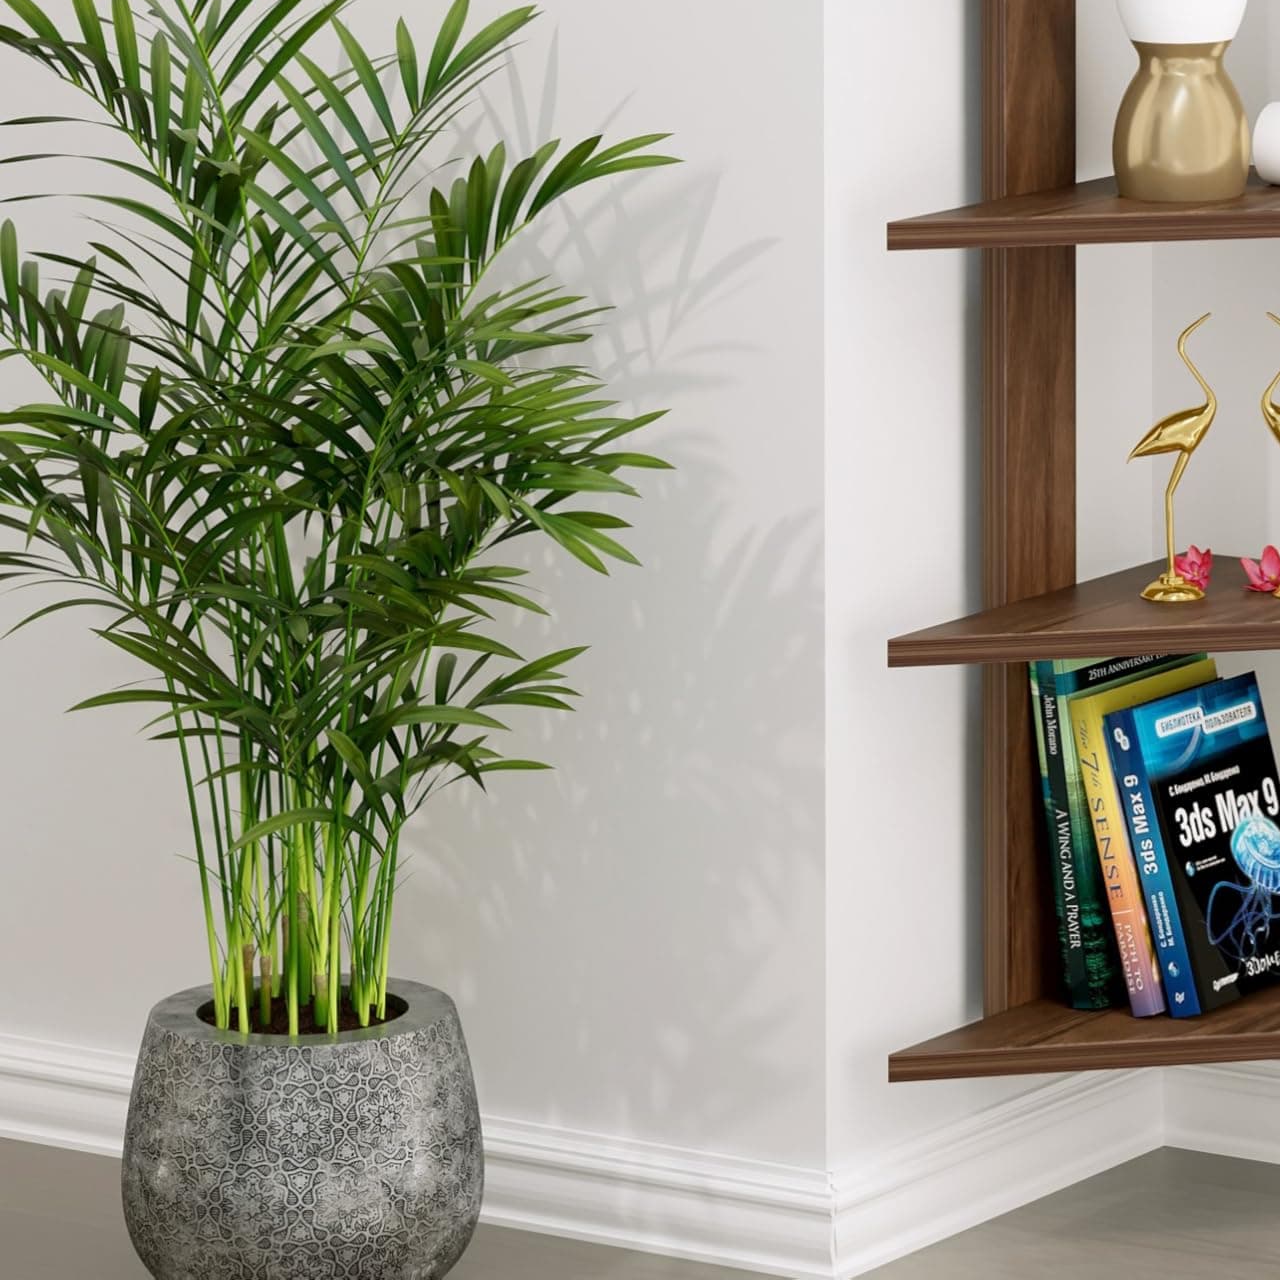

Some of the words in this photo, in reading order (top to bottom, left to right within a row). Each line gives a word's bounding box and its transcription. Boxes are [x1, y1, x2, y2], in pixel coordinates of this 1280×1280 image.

[1088, 666, 1107, 681] 25TH
[1043, 694, 1055, 719] John
[1204, 705, 1252, 729] ПОЛЬЗОВАТЕЛЯ
[1160, 711, 1201, 733] БИБЛИОТЕКА
[1123, 774, 1139, 788] 9
[1055, 809, 1068, 820] A
[1130, 791, 1150, 835] Max
[1174, 801, 1217, 848] 3ds
[1214, 788, 1265, 833] Max
[1261, 776, 1280, 817] 9
[1057, 821, 1072, 859] WING
[1090, 797, 1124, 900] SENSE
[1139, 839, 1159, 876] 3ds
[1061, 861, 1075, 891] AND
[1064, 891, 1076, 902] A
[1066, 904, 1081, 950] PRAYER
[1124, 924, 1139, 963] PATH
[1134, 967, 1144, 991] TO
